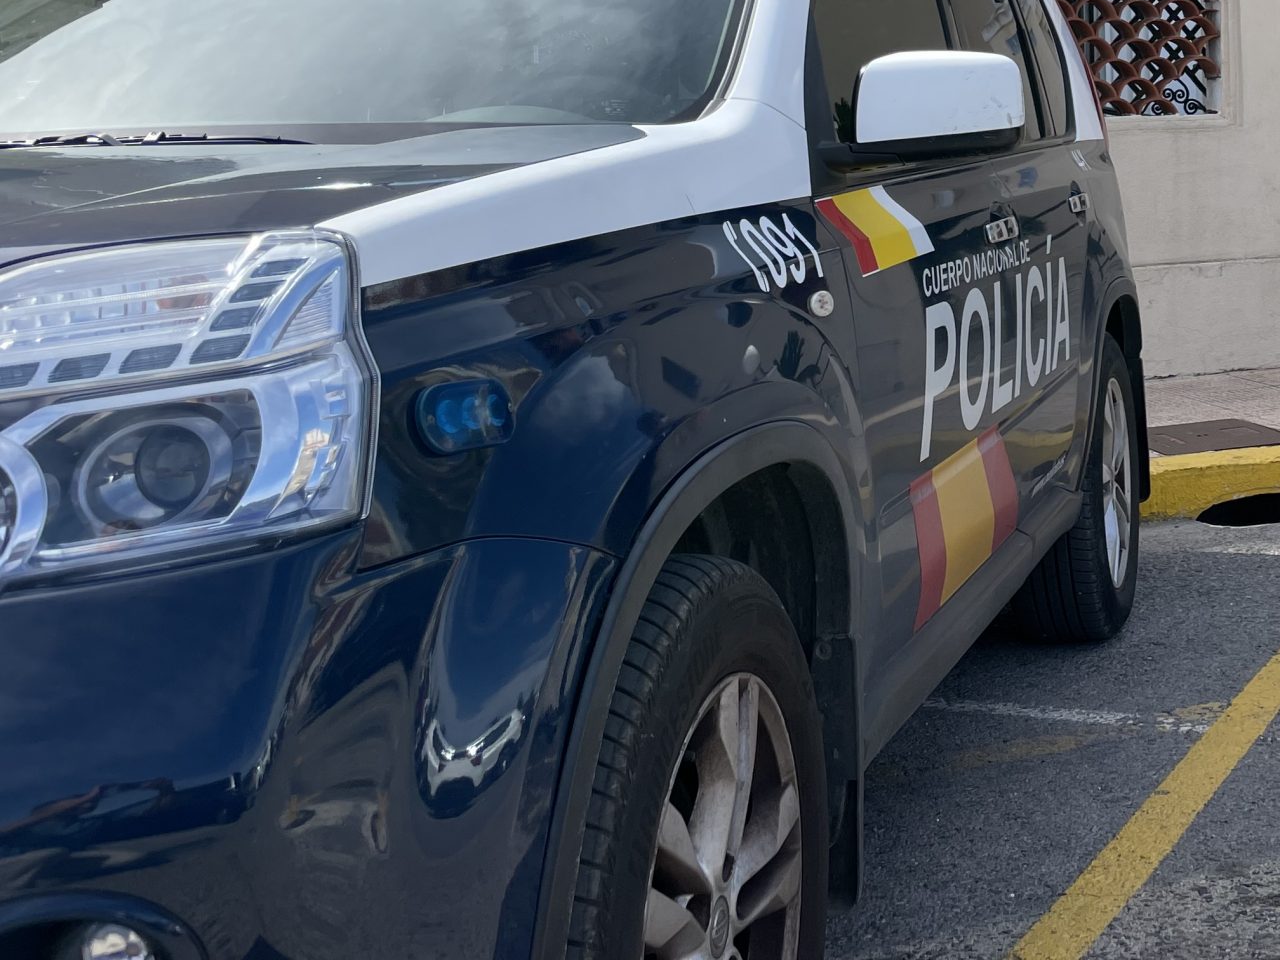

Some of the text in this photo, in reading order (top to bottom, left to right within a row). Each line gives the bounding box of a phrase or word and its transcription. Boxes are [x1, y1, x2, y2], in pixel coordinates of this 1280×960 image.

[922, 239, 1031, 297] CUERPO NACIONAL DE
[919, 234, 1070, 463] POLICÍA
